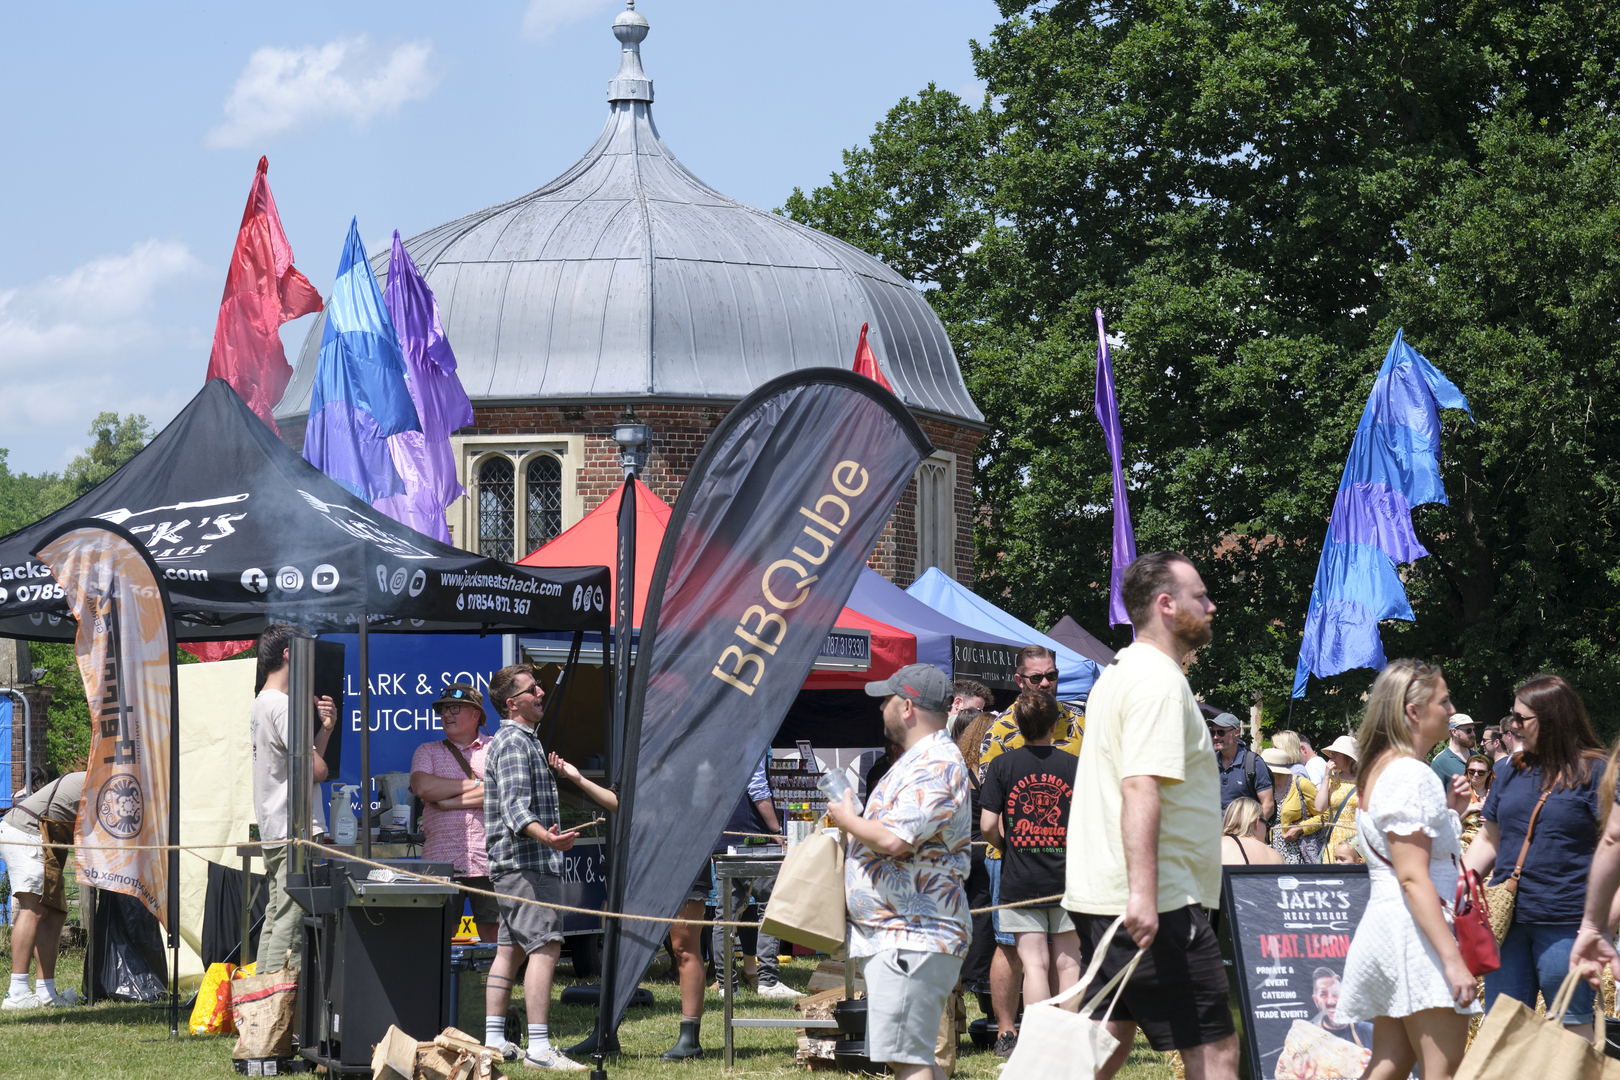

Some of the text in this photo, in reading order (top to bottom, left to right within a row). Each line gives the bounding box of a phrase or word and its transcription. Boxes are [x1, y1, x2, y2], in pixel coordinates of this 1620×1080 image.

[441, 569, 563, 597] www.jacksmeatshack.com
[711, 460, 869, 696] BBQube
[513, 597, 531, 615] 367
[820, 636, 865, 656] 1787 319330
[343, 672, 407, 696] LARK
[415, 673, 433, 695] &
[352, 708, 443, 732] BUTCHE
[1007, 773, 1073, 815] NORFOLK SMOKE
[585, 856, 596, 884] &
[1276, 890, 1351, 910] JACK'S
[462, 918, 472, 933] X
[1283, 911, 1348, 921] MEAT SHACK
[1259, 933, 1305, 959] MEAT.
[1256, 966, 1295, 975] PRIVATE &
[1264, 978, 1289, 987] EVENT
[1261, 991, 1297, 999] CATERING
[1254, 1009, 1309, 1019] TRADE EVENTS
